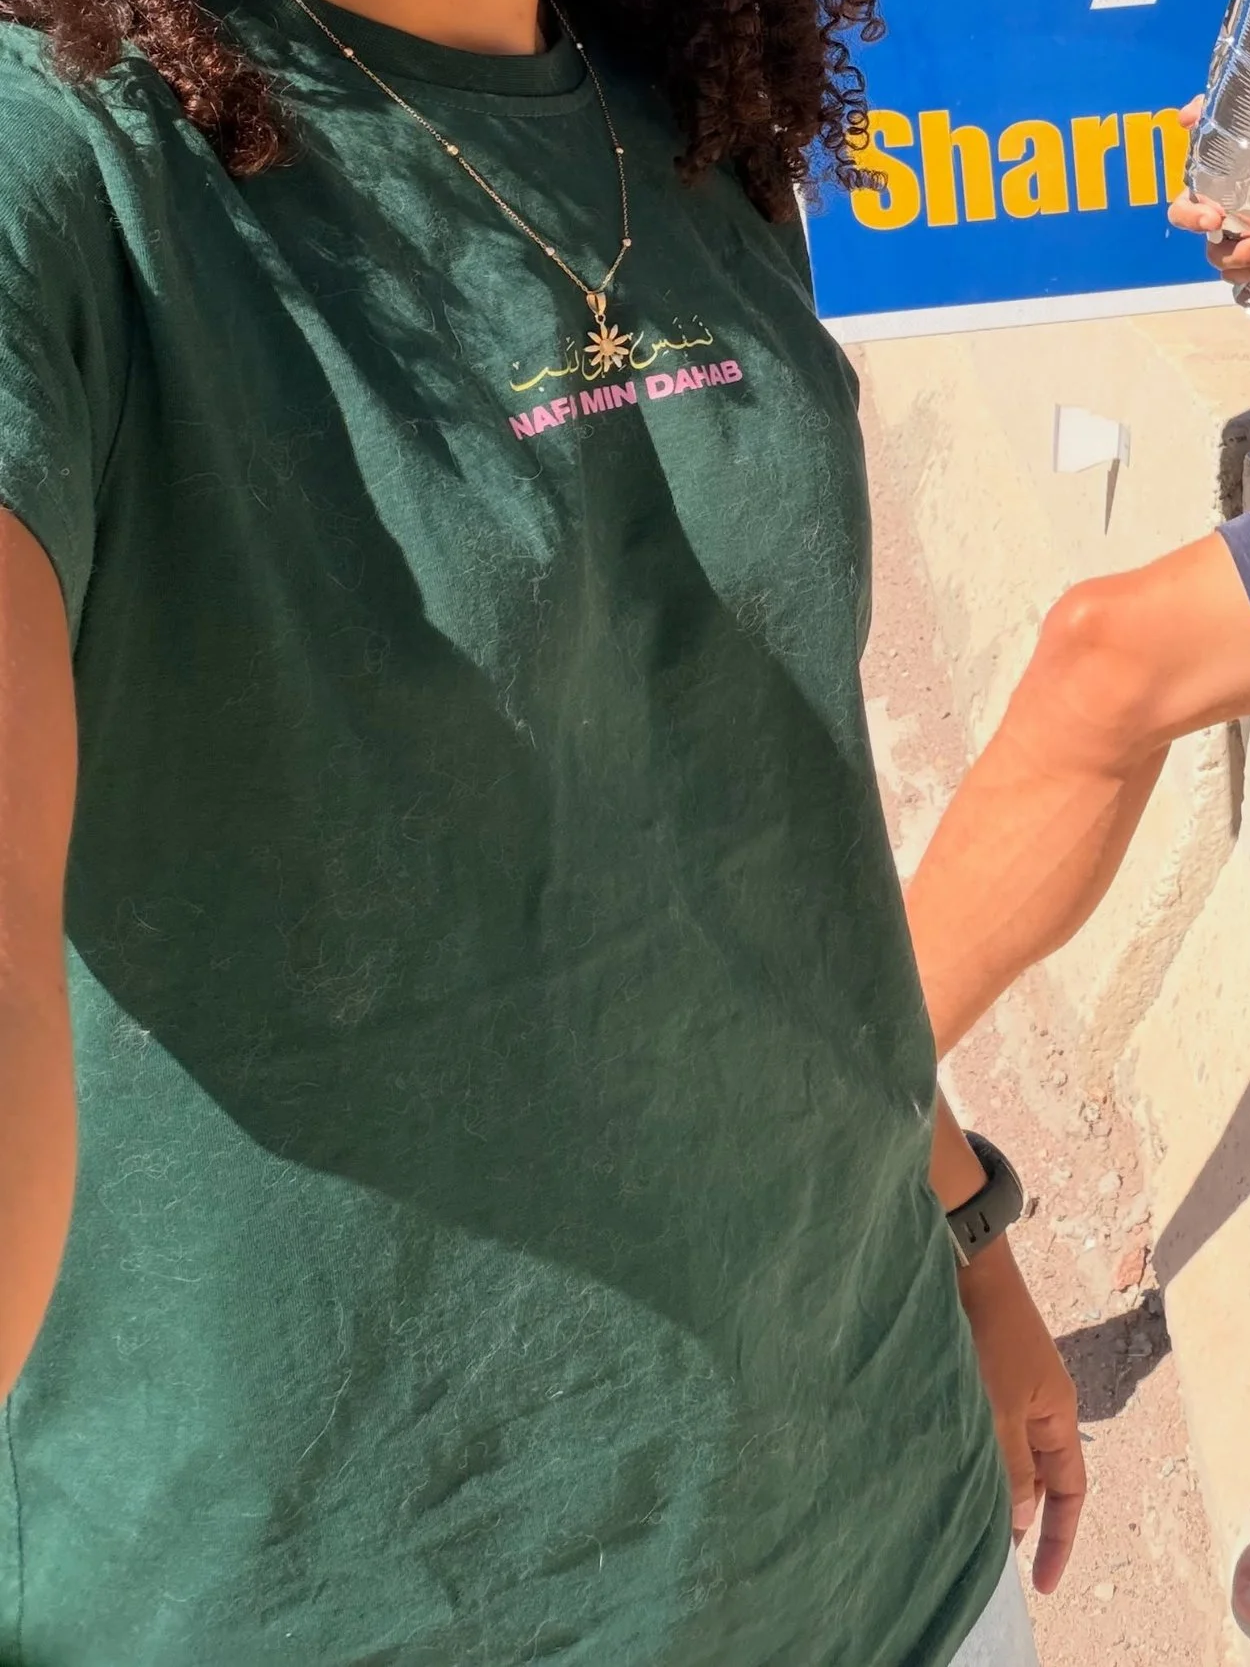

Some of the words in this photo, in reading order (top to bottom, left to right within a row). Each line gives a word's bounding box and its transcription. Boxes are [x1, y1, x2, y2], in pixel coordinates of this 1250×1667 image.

[508, 394, 578, 441] NAF
[579, 381, 638, 416] MIN
[644, 359, 743, 401] DAHAB
